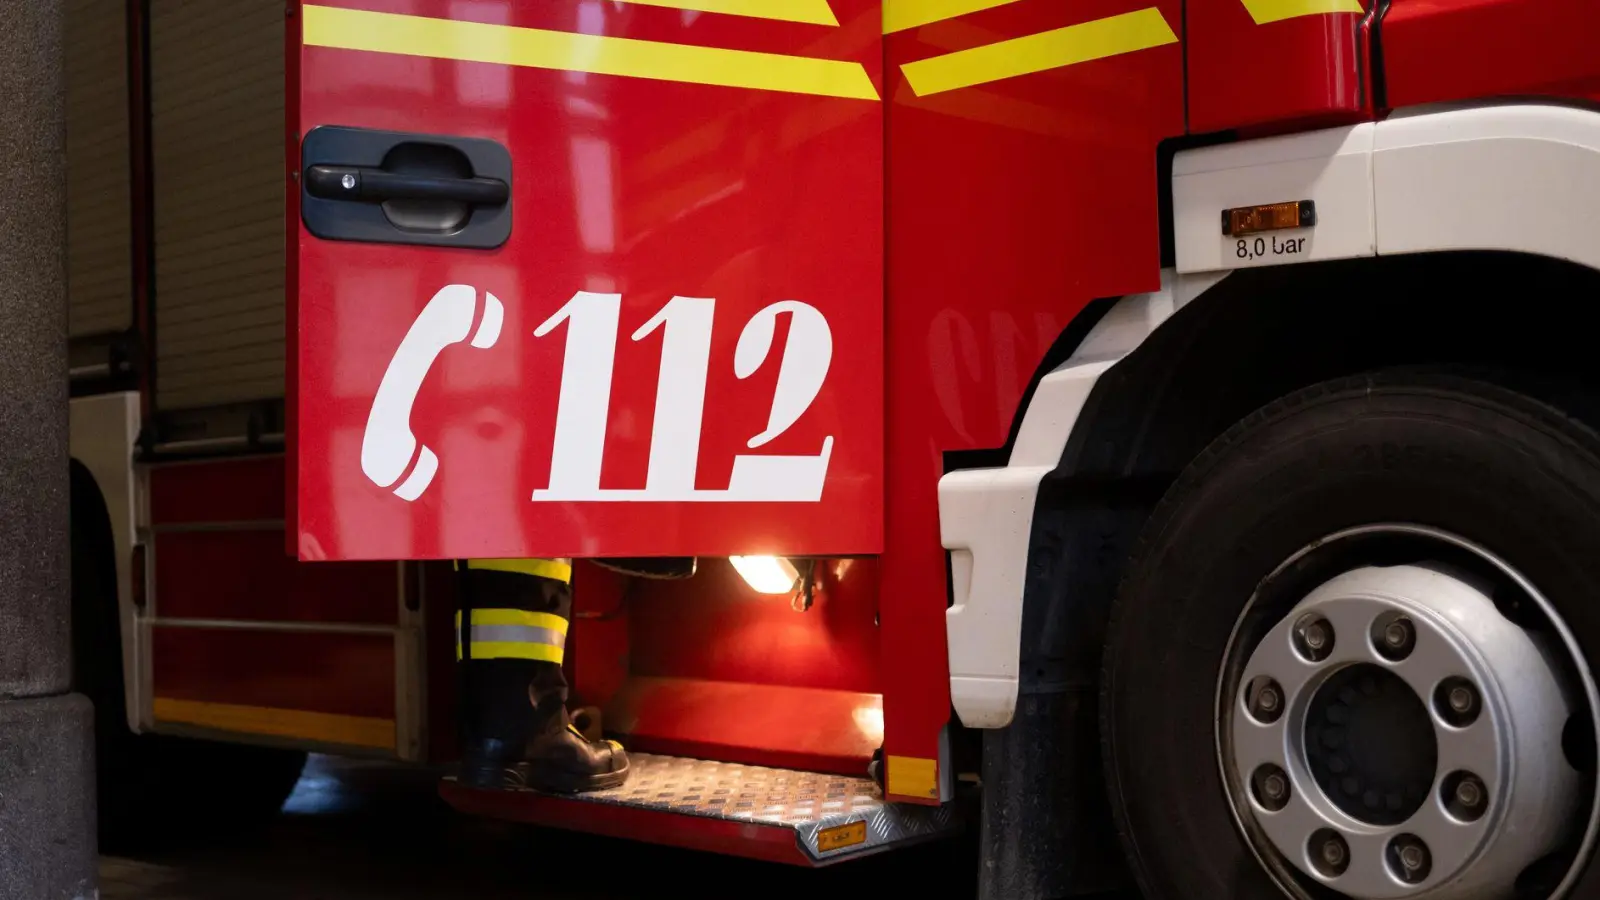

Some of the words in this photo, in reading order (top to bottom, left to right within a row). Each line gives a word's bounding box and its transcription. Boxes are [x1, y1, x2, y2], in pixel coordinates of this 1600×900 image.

[1236, 238, 1266, 260] 8,0
[1272, 235, 1306, 255] bar
[532, 291, 834, 502] 112
